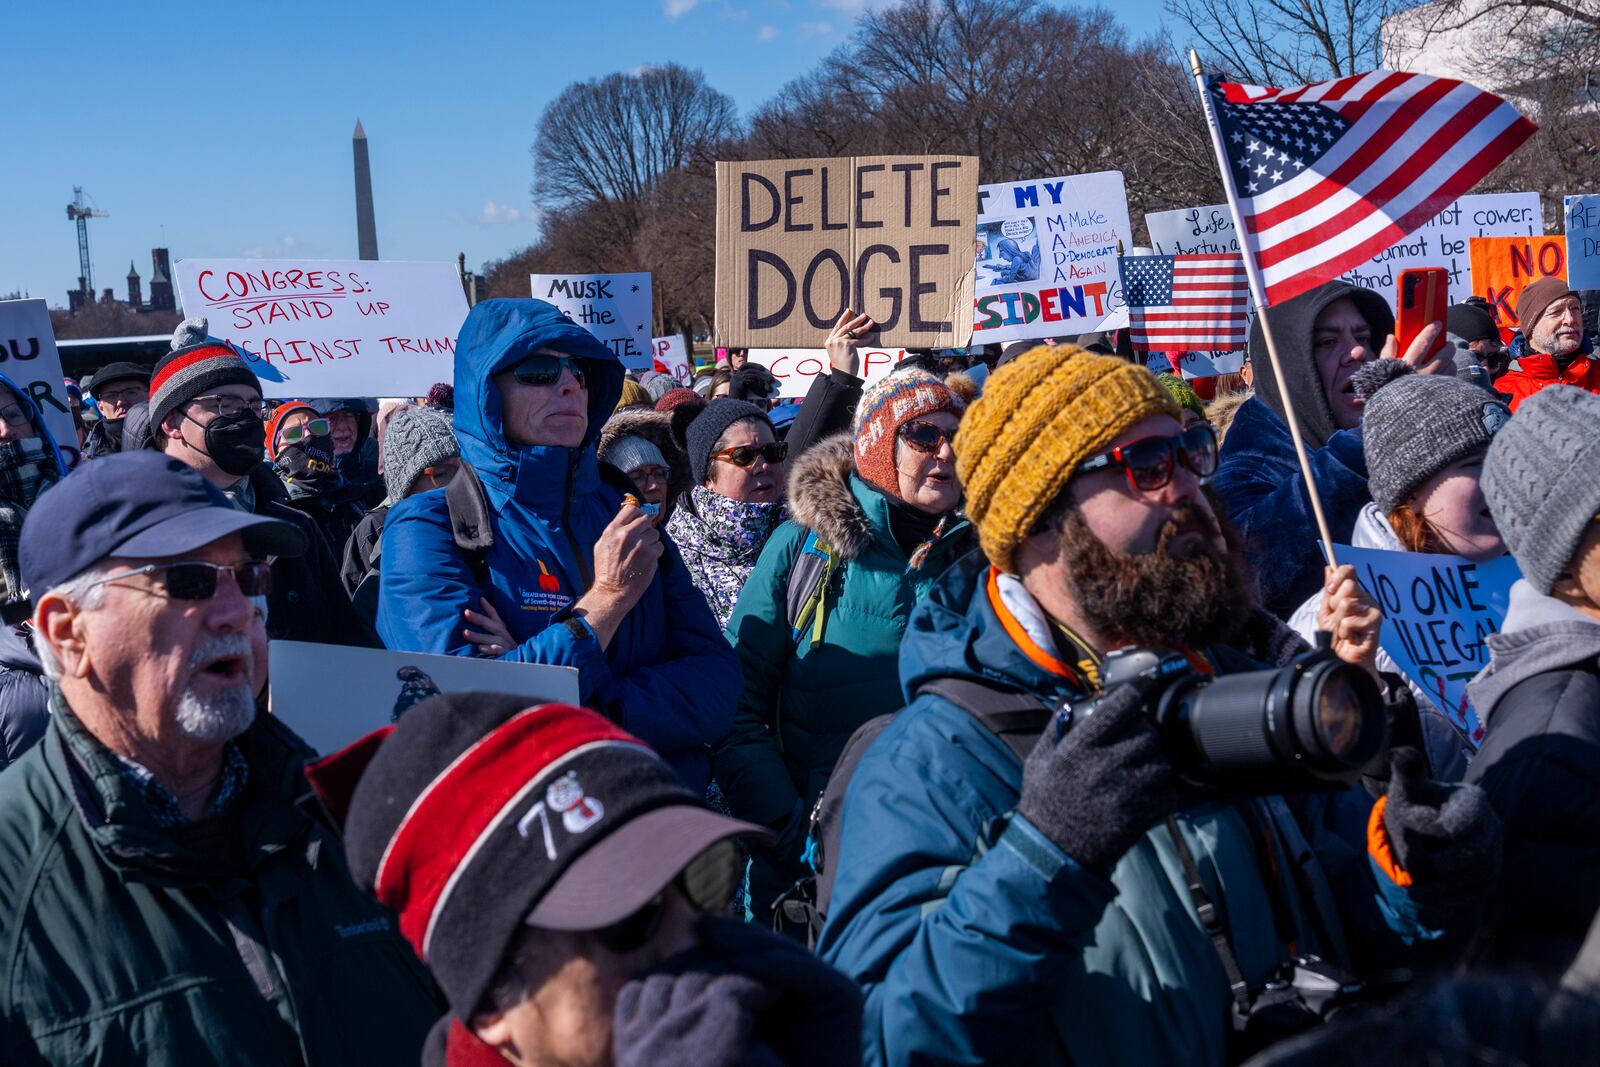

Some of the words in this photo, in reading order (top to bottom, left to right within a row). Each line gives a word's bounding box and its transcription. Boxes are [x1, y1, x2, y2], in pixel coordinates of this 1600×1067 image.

[741, 161, 961, 233] DELETE
[1013, 181, 1065, 208] MY
[1185, 208, 1235, 237] Life,
[1473, 207, 1534, 227] cower.
[1440, 233, 1465, 257] be
[1509, 241, 1565, 278] NO
[198, 268, 372, 302] CONGRESS:
[547, 279, 615, 299] MUSK
[747, 243, 953, 333] DOGE
[232, 301, 334, 330] STAND
[358, 300, 391, 317] UP
[579, 304, 616, 325] the
[378, 336, 457, 355] TRUM
[1357, 563, 1400, 620] NO
[1411, 563, 1487, 616] ONE
